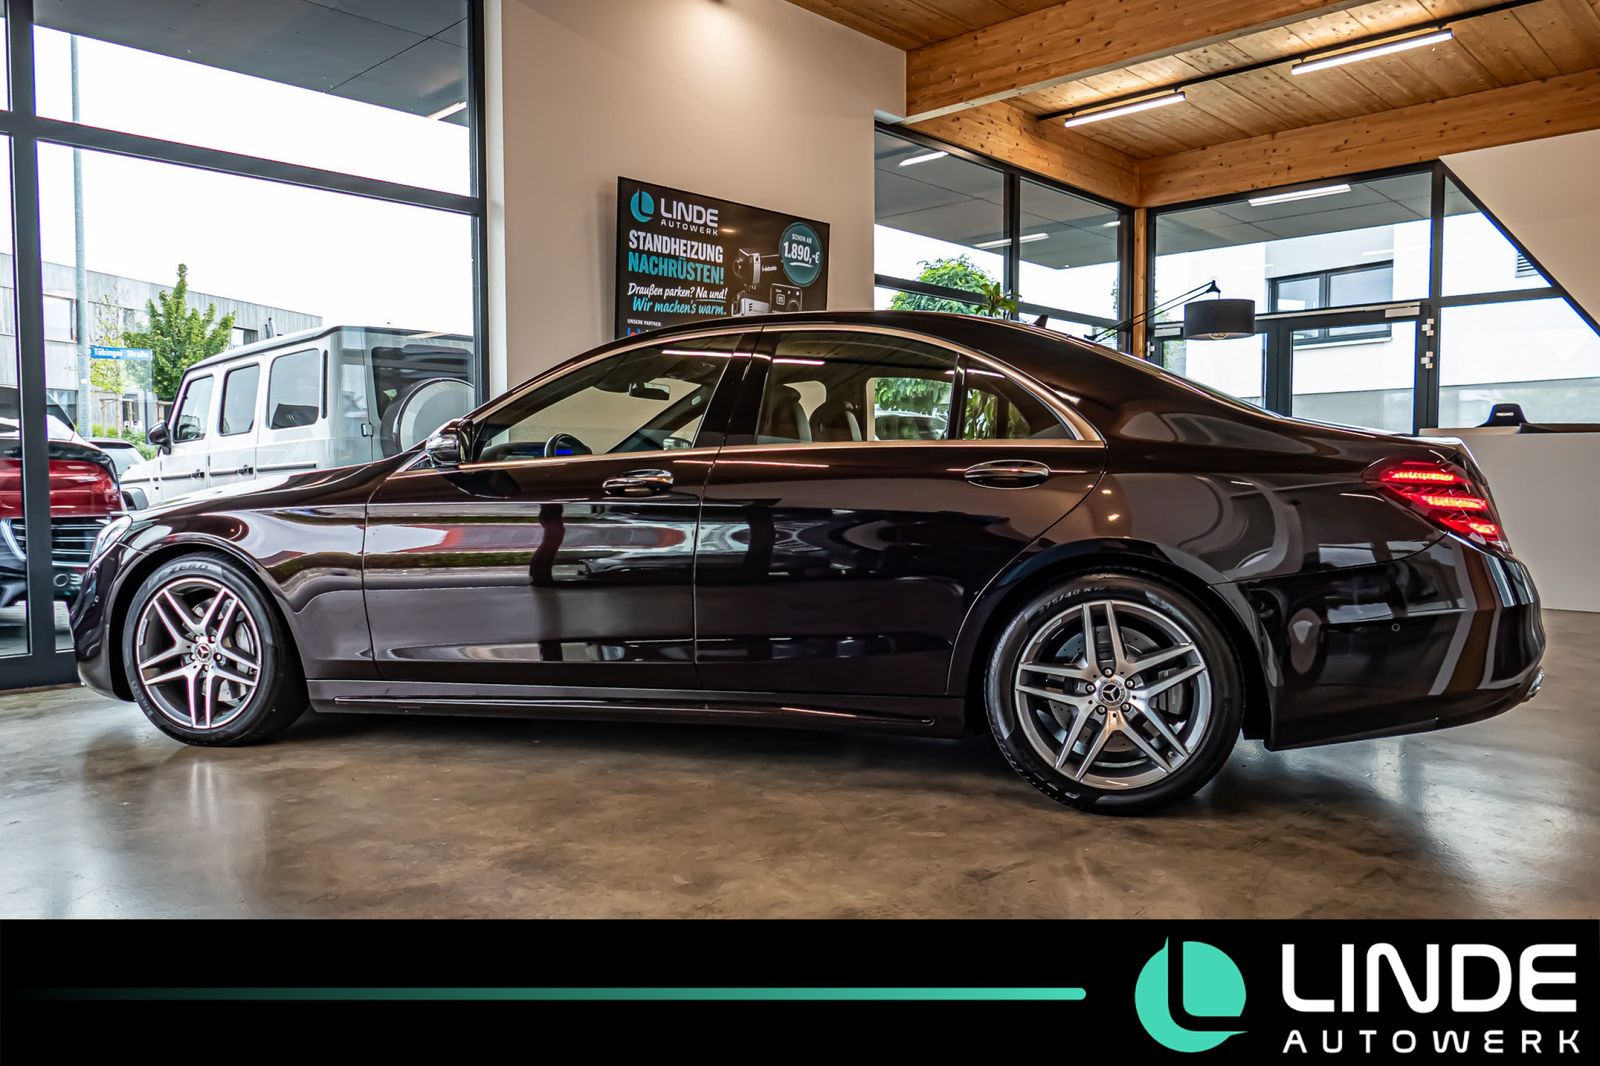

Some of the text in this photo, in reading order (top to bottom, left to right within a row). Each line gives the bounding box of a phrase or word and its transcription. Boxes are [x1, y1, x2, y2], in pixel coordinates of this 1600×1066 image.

[661, 198, 719, 228] LINDE
[660, 219, 718, 237] AUTOWERK
[792, 233, 806, 243] SCHON
[628, 229, 724, 264] STANDHEIZUNG
[628, 251, 725, 286] NACHRÜSTEN!
[627, 282, 728, 300] Draußen parken? Na und!
[633, 295, 727, 316] Wir machen's warm.
